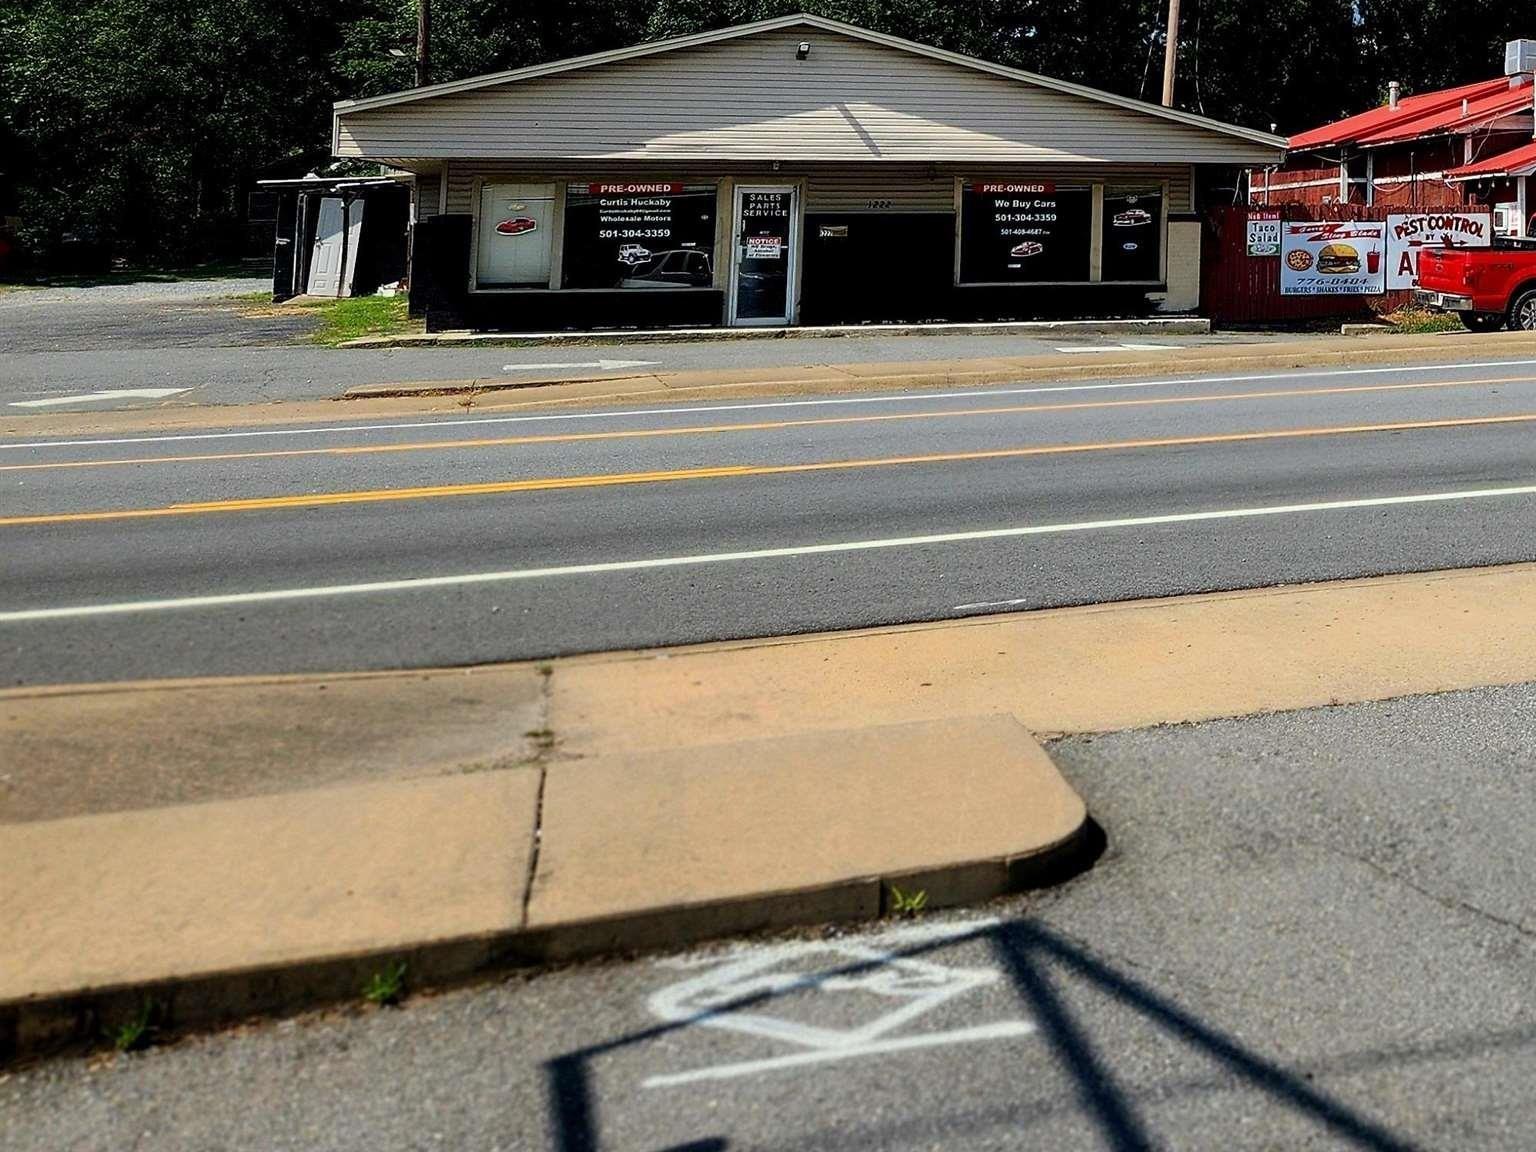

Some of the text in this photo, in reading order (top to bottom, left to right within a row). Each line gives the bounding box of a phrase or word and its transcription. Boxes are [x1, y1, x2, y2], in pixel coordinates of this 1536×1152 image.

[600, 184, 672, 193] PRE-OWNED
[983, 184, 1045, 193] PRE-OWNED
[599, 198, 672, 208] Curtis Huckaby
[994, 199, 1057, 209] We Buy Cars
[743, 209, 788, 217] SERVICE
[994, 213, 1057, 222] 501-304-3359
[600, 215, 642, 223] Wholesale
[1252, 222, 1275, 232] Taco
[1394, 215, 1485, 240] PEST CONTROL
[599, 229, 671, 238] 501-304-3359
[1249, 233, 1278, 243] Salad
